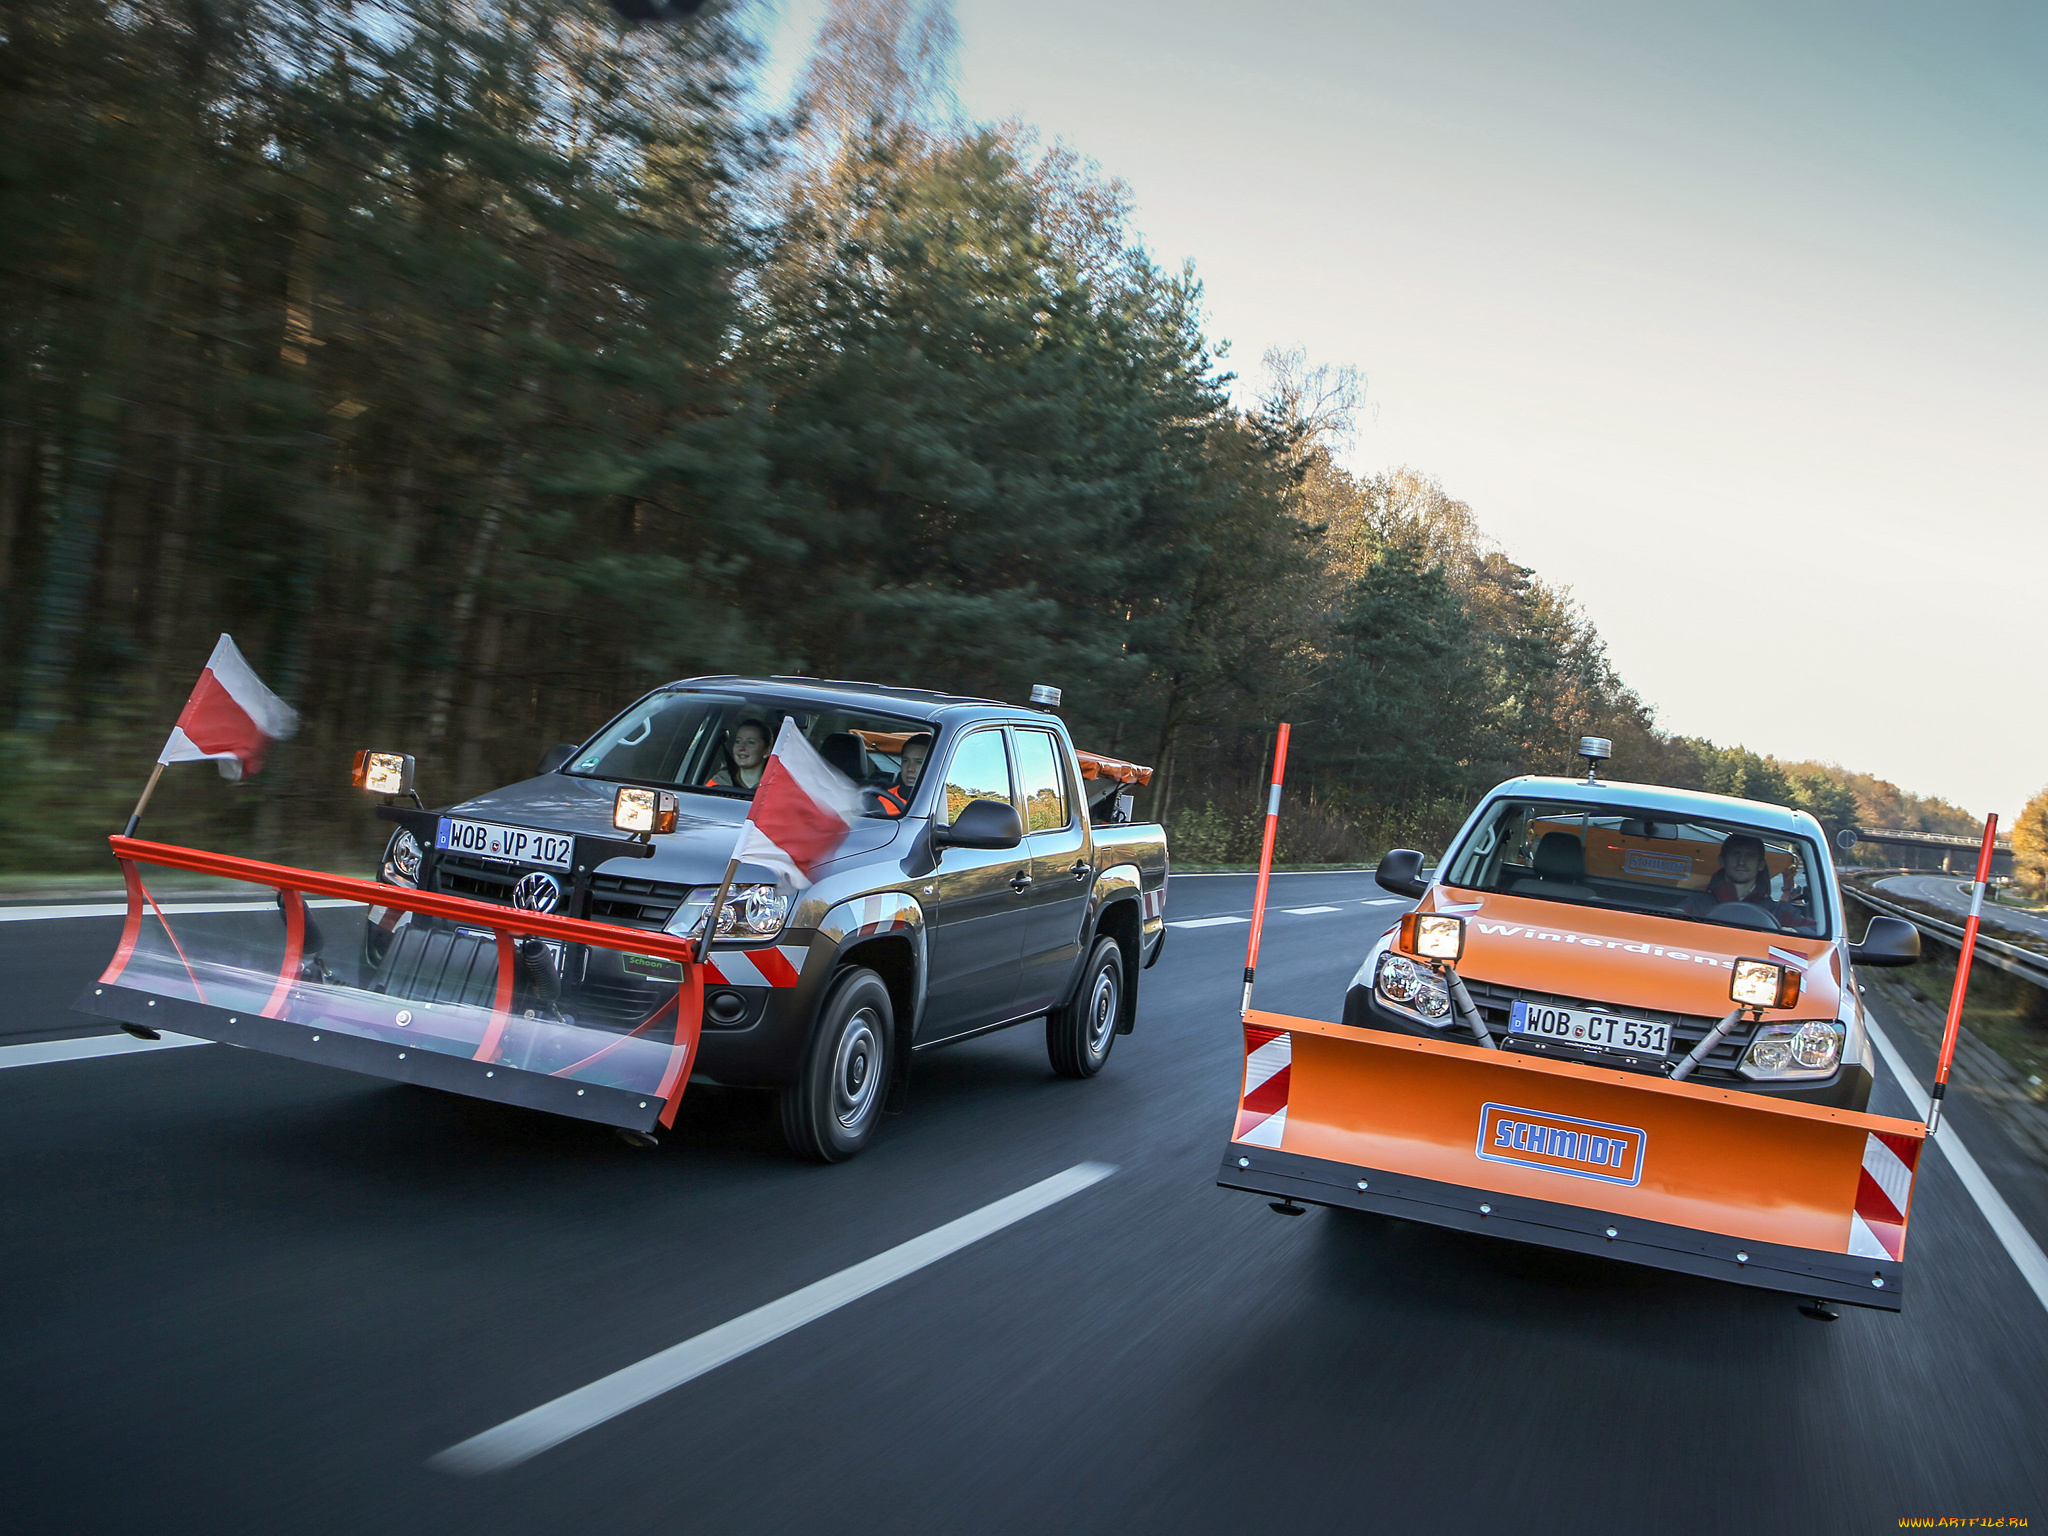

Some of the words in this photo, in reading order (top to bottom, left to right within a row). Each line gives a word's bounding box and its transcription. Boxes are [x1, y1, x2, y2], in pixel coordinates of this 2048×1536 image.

[450, 822, 487, 851] WOB
[503, 830, 528, 857] VP
[531, 836, 571, 864] 102
[1630, 855, 1687, 874] SCHMIDT
[629, 956, 663, 969] Schoon
[1476, 922, 1735, 970] Winterdiens
[1527, 1007, 1571, 1036] WOB
[1587, 1016, 1619, 1043] CT
[1622, 1021, 1666, 1052] 531
[1494, 1118, 1628, 1168] SCHMIDT
